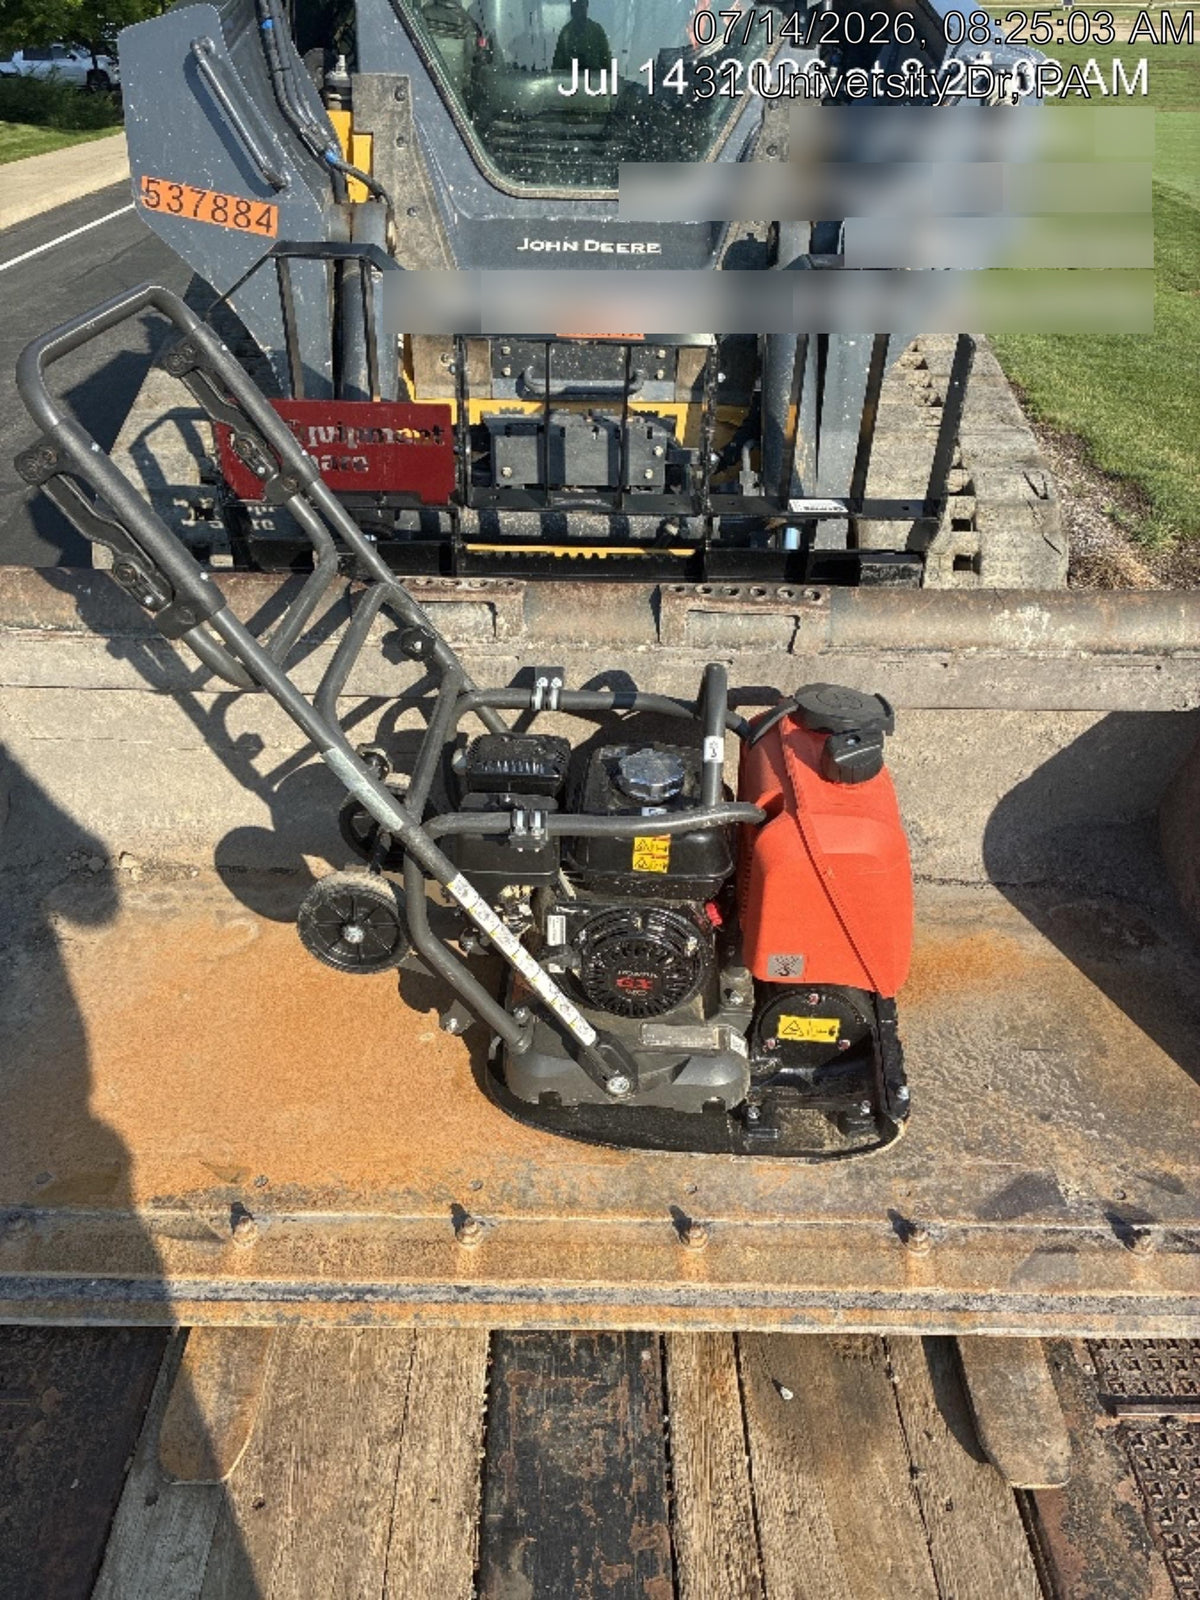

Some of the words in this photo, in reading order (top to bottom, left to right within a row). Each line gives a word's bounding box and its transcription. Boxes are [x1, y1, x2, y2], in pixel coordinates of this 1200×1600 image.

[144, 179, 273, 234] 537884
[516, 237, 579, 252] JOHN
[583, 239, 662, 255] DEERE
[285, 418, 446, 449] quipment
